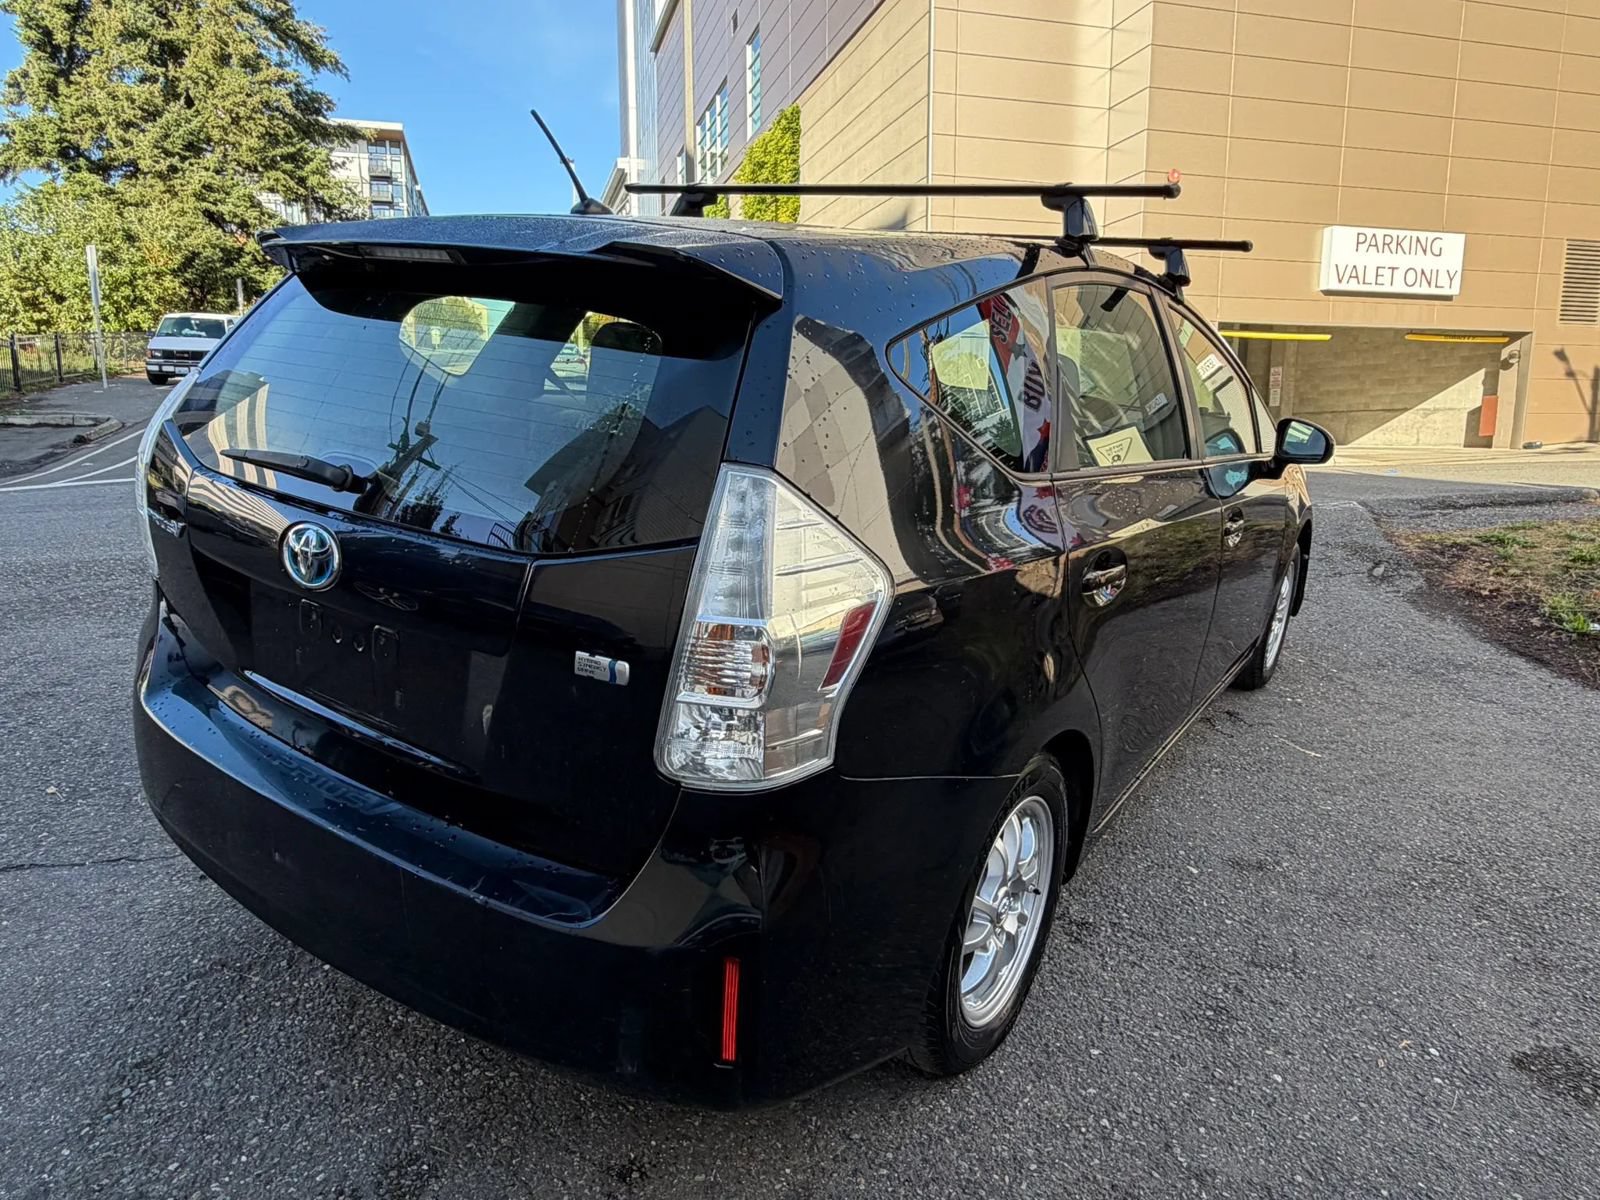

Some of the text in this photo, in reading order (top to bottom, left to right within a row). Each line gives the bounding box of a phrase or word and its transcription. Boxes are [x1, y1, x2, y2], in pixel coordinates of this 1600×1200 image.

[1355, 232, 1443, 257] PARKING
[1335, 264, 1458, 289] VALET ONLY
